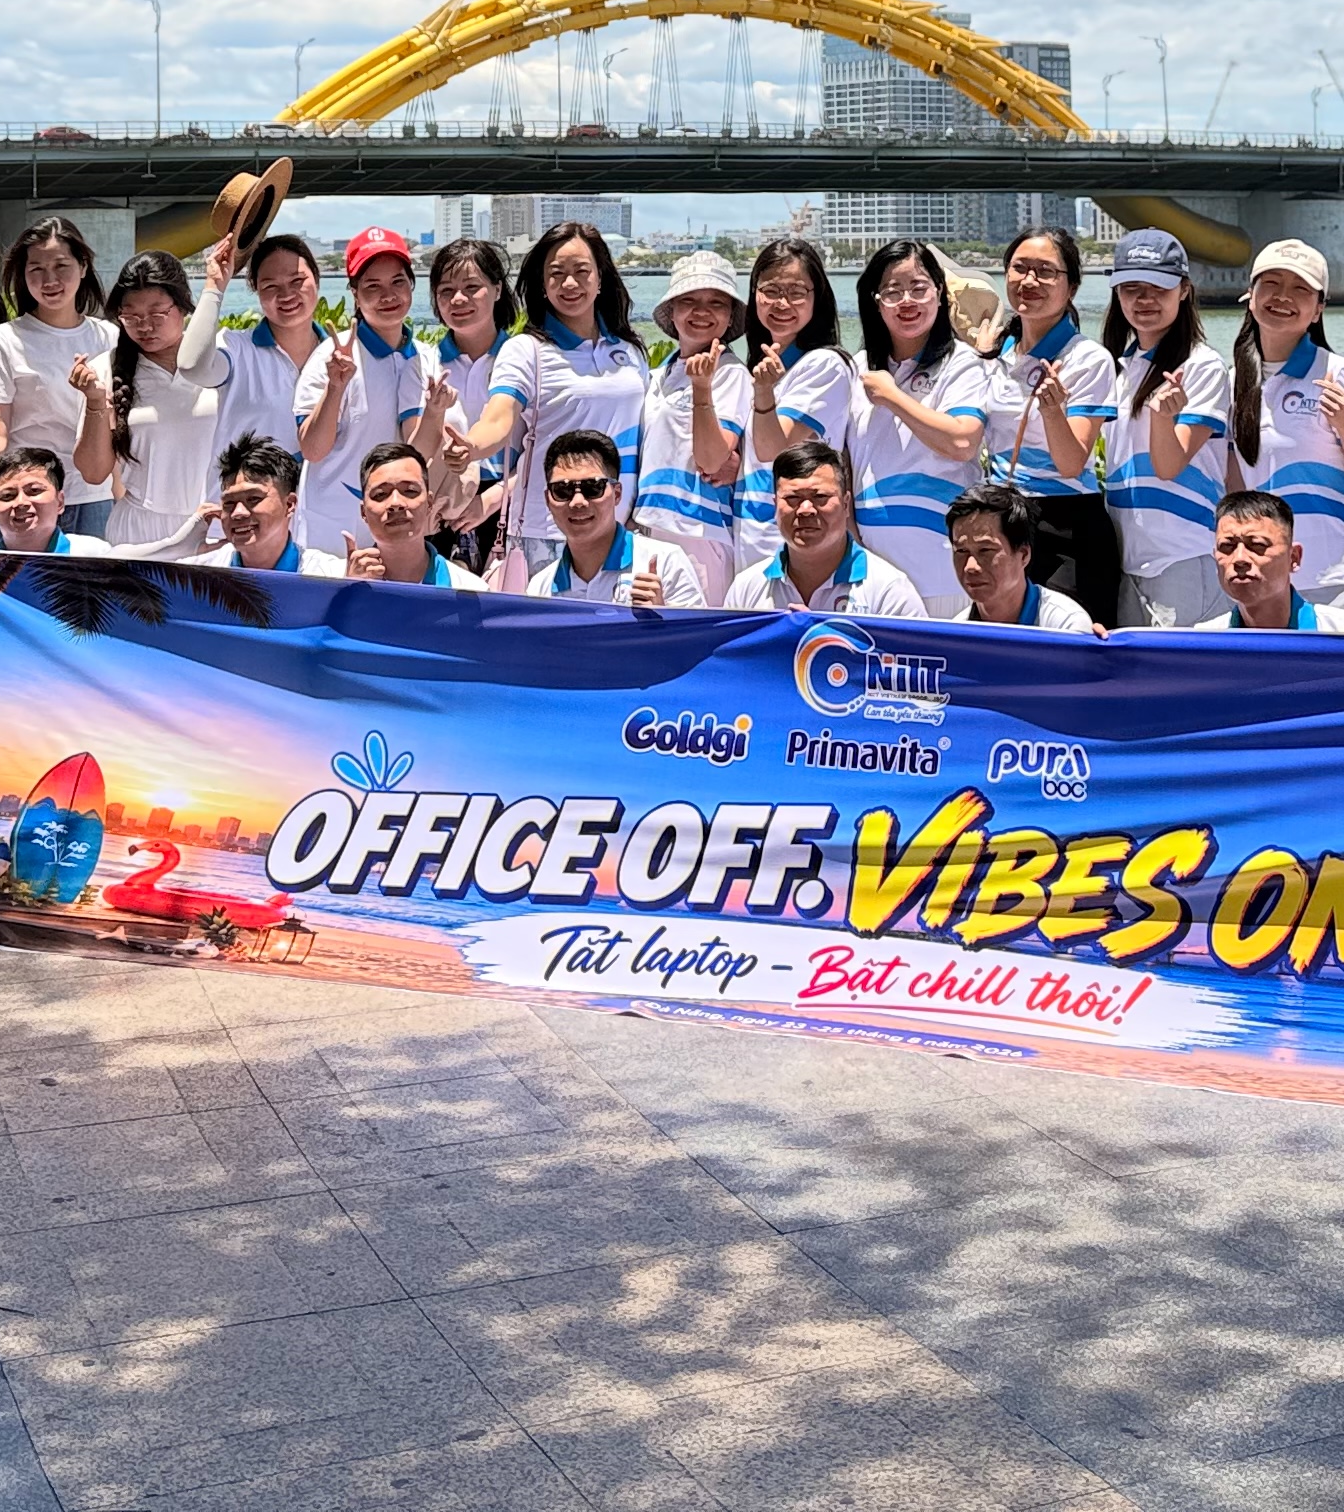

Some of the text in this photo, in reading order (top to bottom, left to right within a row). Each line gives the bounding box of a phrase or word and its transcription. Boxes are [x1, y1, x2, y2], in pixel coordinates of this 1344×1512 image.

[624, 708, 752, 764] Goldgi
[265, 787, 624, 906] OFFICE
[617, 800, 841, 919] OFF.
[844, 786, 1218, 966] VIBES
[540, 924, 633, 982] Tắt
[630, 925, 758, 995] laptop
[797, 945, 911, 1001] Bật
[908, 959, 1019, 1006] chill
[1025, 971, 1154, 1026] thôi!
